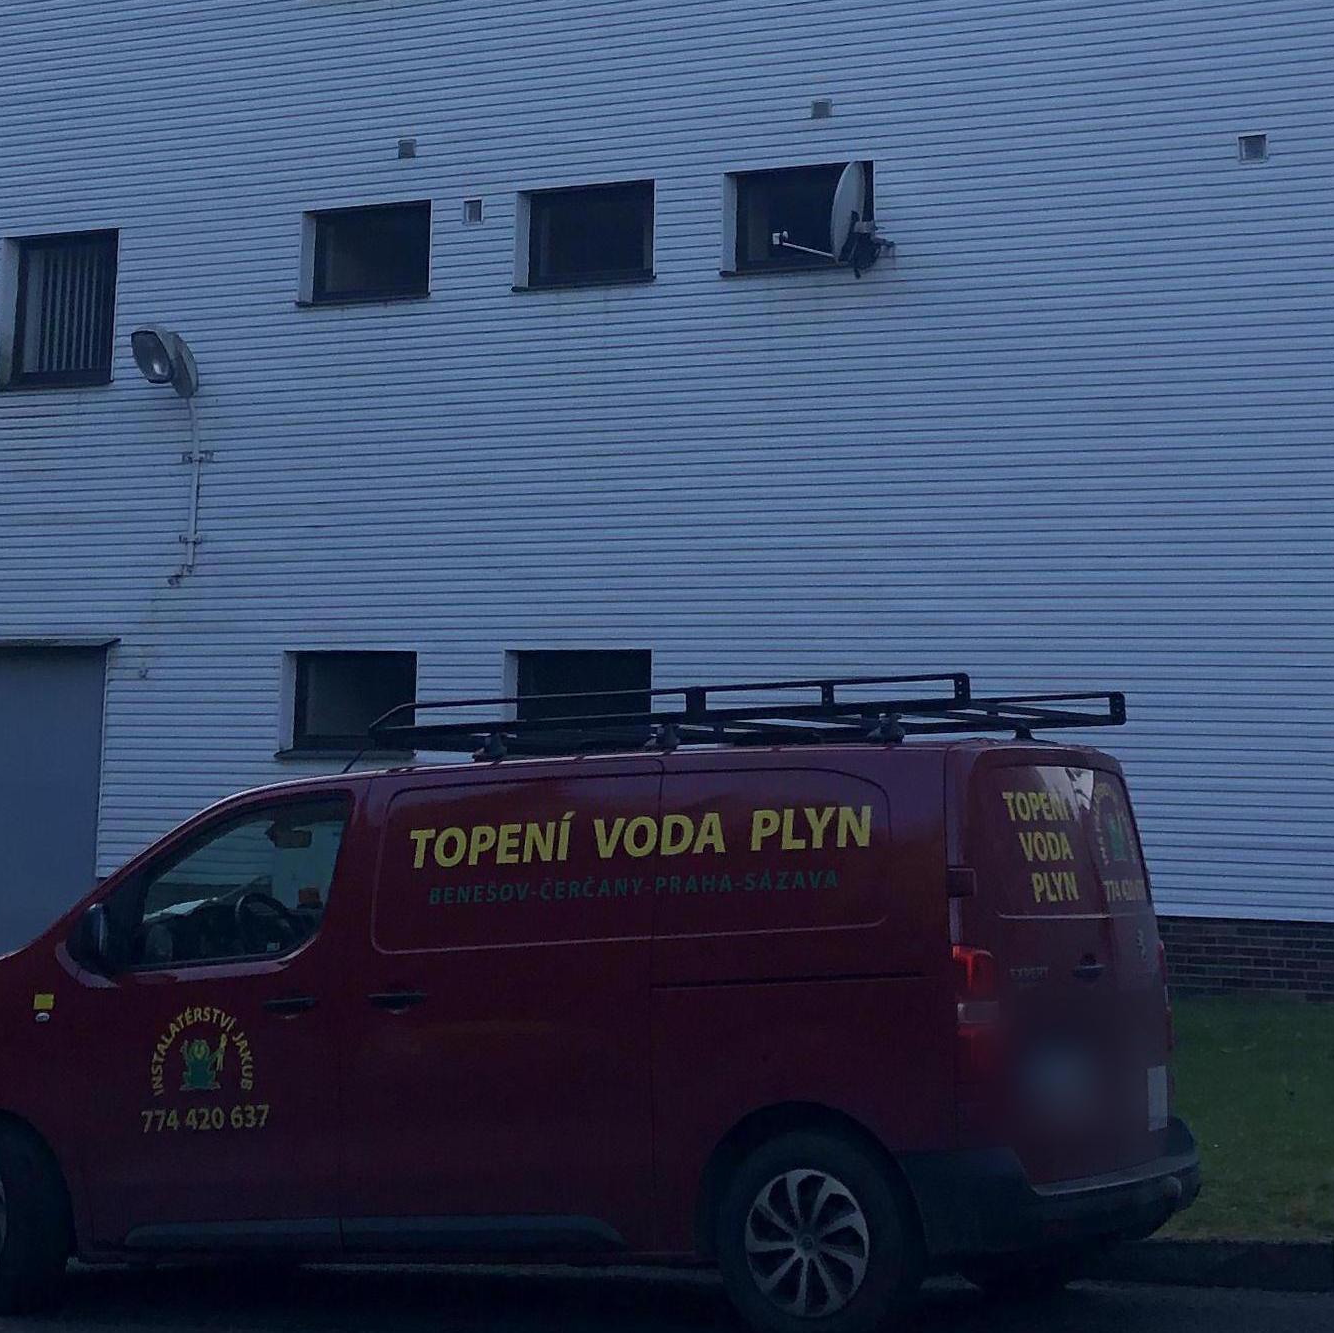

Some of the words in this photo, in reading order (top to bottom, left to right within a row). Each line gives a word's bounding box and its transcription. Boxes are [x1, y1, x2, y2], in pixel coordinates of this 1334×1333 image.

[410, 811, 576, 868] TOPENÍ
[594, 813, 725, 859] VODA
[750, 806, 872, 851] PLYN
[1019, 832, 1074, 862] VODA
[1031, 872, 1080, 903] PLYN
[233, 1032, 253, 1090] JAKUB
[142, 1110, 180, 1133] 774
[185, 1107, 224, 1130] 420
[231, 1104, 269, 1128] 637
